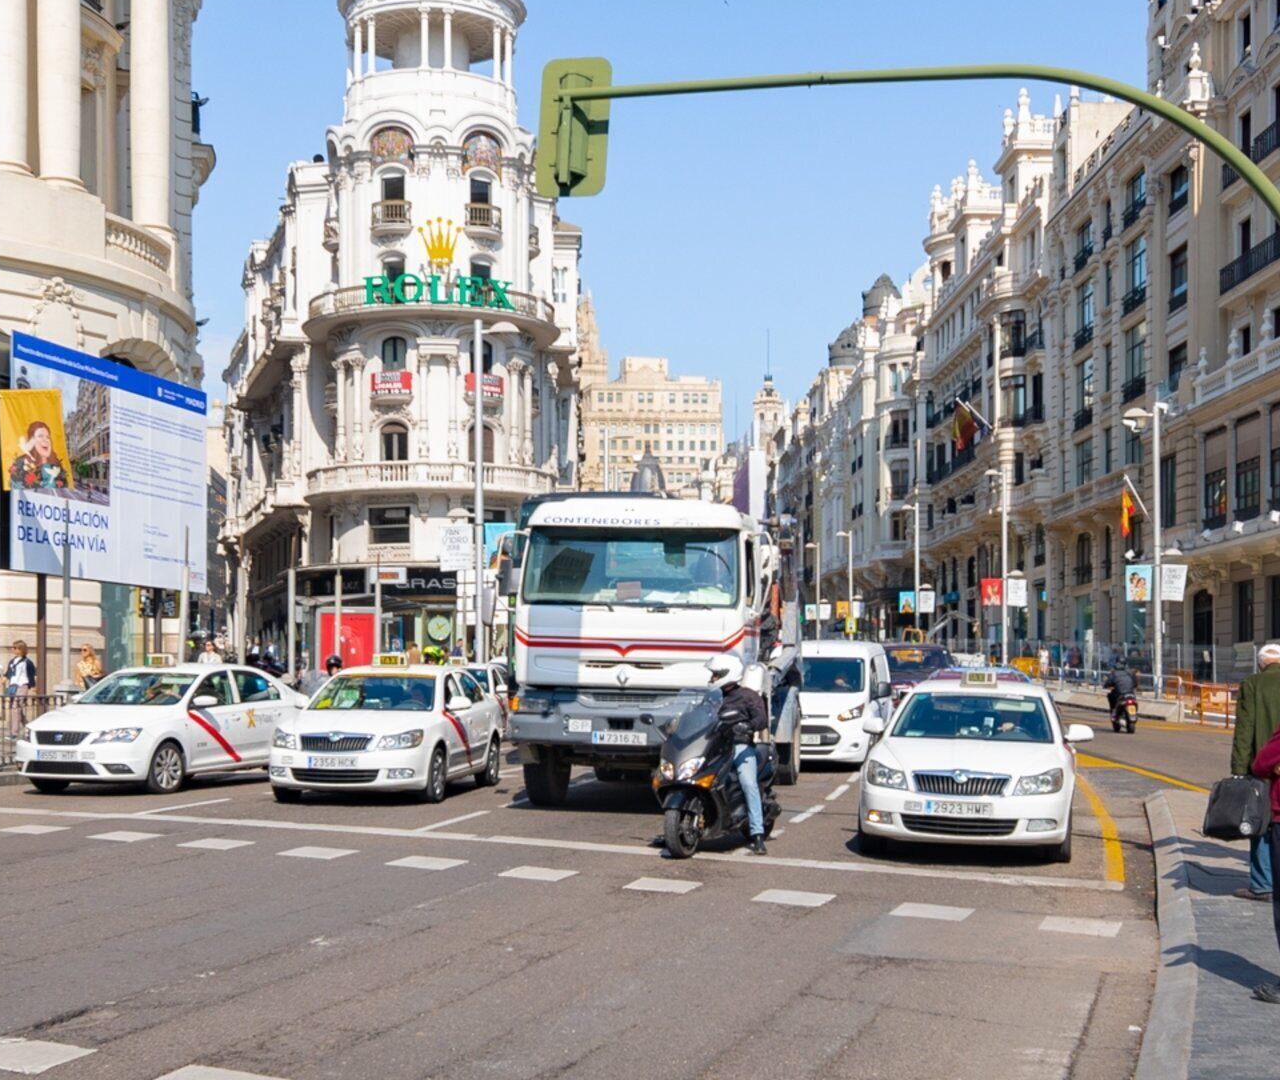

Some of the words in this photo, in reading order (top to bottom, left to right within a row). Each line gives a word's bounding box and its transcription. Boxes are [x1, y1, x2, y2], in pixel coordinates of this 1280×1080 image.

[363, 274, 516, 311] ROLEX
[17, 500, 109, 530] REMODELACIÓN
[544, 515, 661, 526] CONTENEDORES
[17, 525, 33, 542] DE
[35, 528, 51, 545] LA
[53, 530, 85, 550] GRAN
[87, 534, 107, 553] VÍA
[607, 734, 629, 743] 7316
[312, 757, 335, 767] 2356
[337, 757, 356, 767] HCK
[934, 802, 962, 814] 2923
